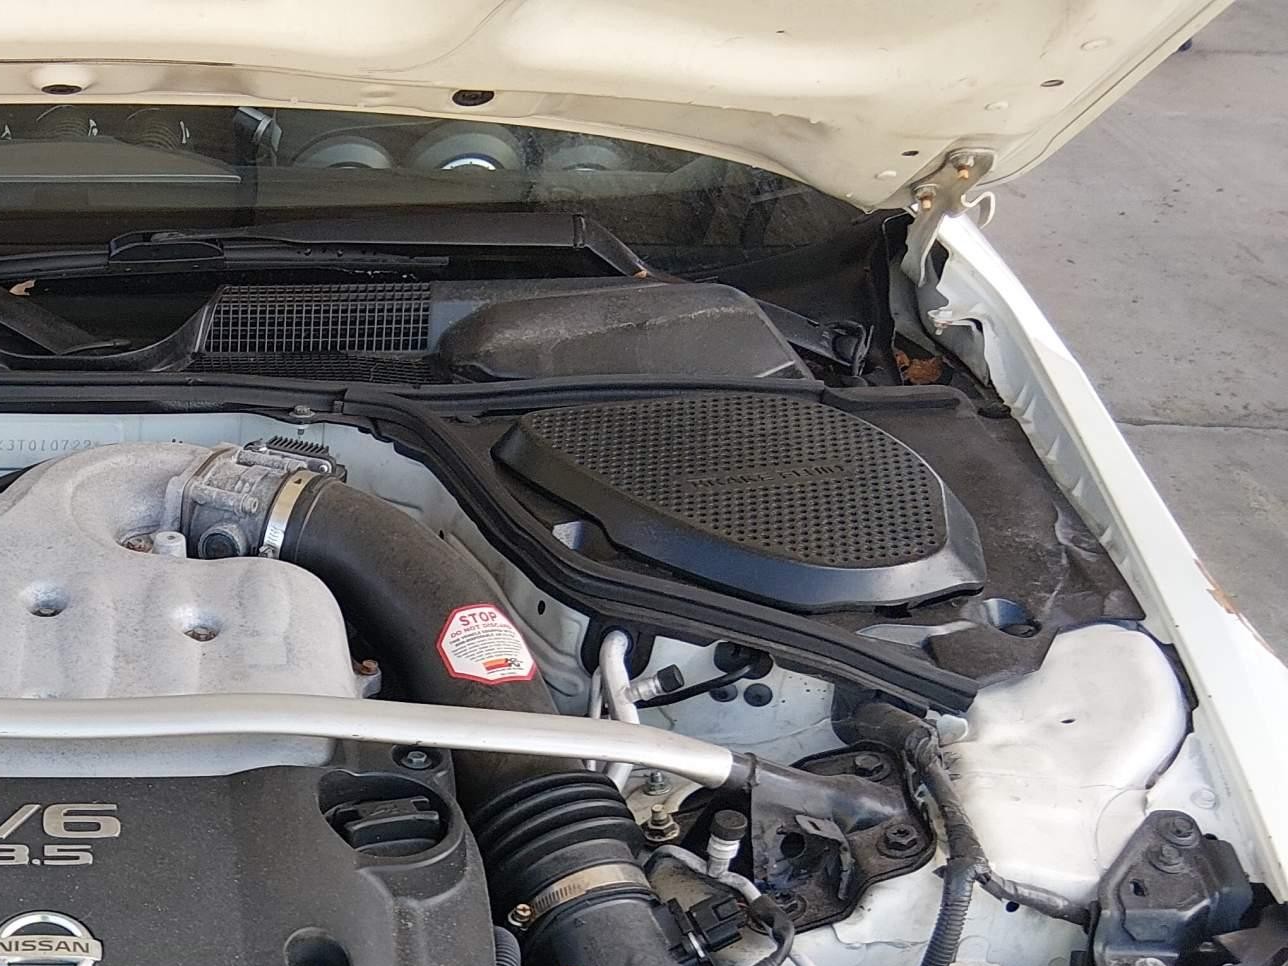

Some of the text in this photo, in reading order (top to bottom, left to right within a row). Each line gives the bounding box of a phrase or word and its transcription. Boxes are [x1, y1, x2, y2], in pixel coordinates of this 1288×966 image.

[690, 464, 845, 489] BRAKE FLUID
[459, 611, 497, 626] STOP
[450, 630, 462, 638] DO
[464, 624, 480, 632] NOT
